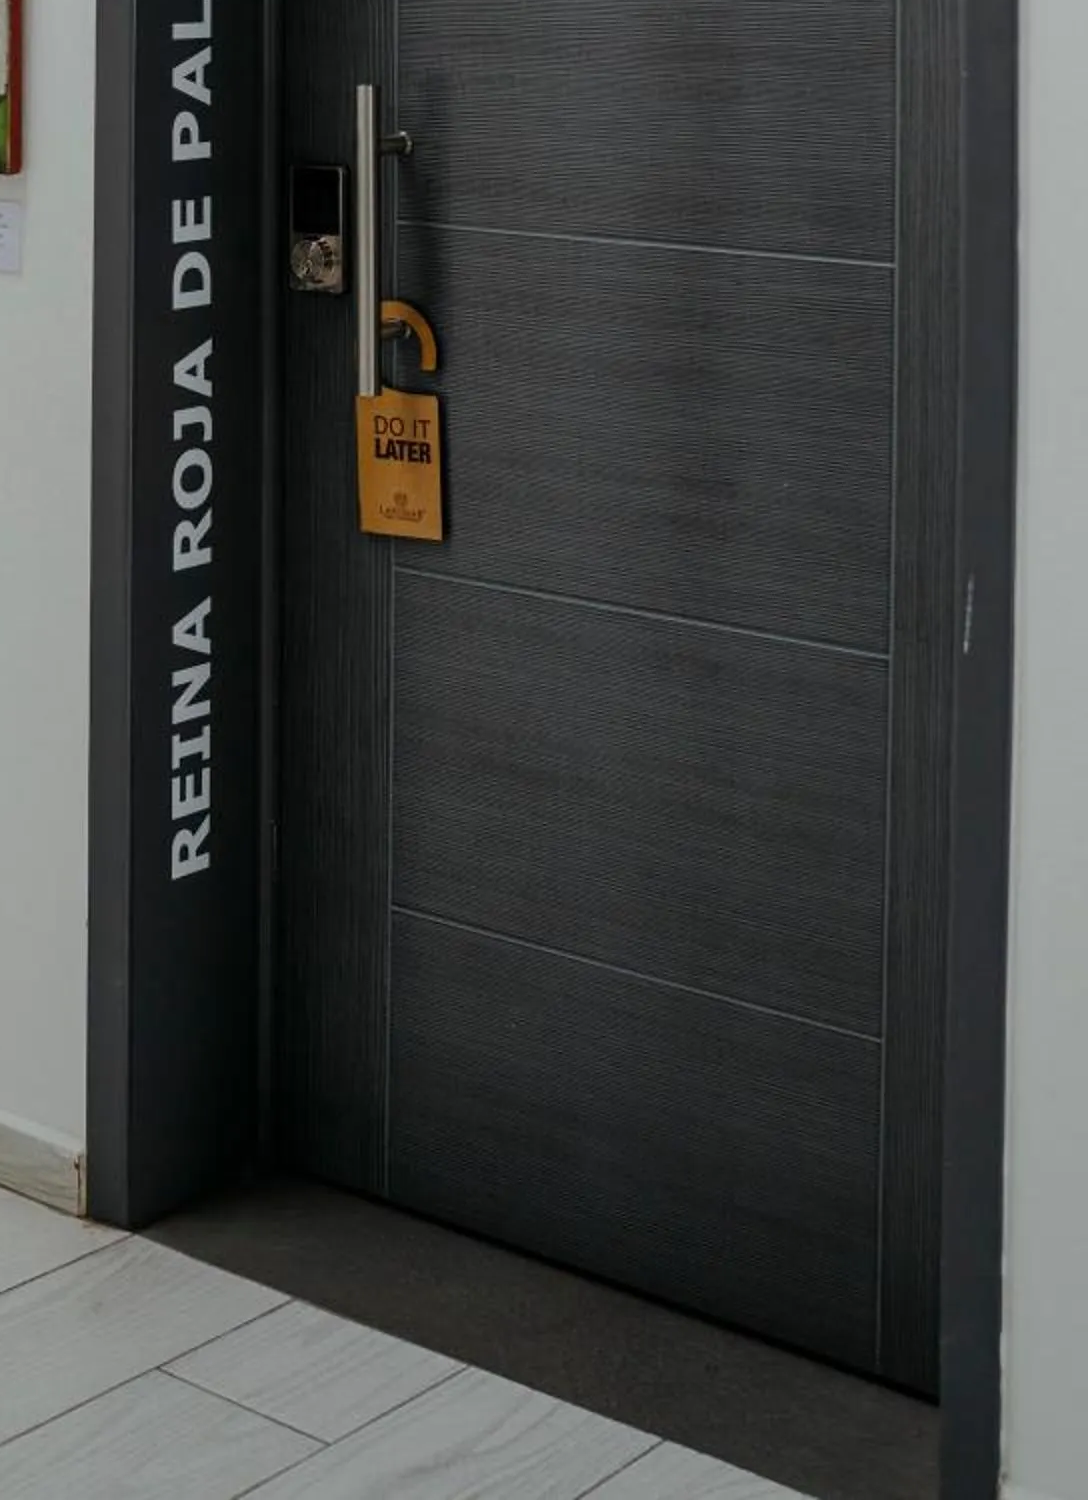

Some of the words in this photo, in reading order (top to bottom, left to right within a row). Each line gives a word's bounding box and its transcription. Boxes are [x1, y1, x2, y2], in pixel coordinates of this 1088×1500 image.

[172, 195, 212, 310] DE
[172, 339, 213, 572] ROJA
[373, 414, 405, 437] DO
[412, 418, 432, 440] IT
[374, 436, 433, 465] LATER
[171, 596, 212, 880] REINA
